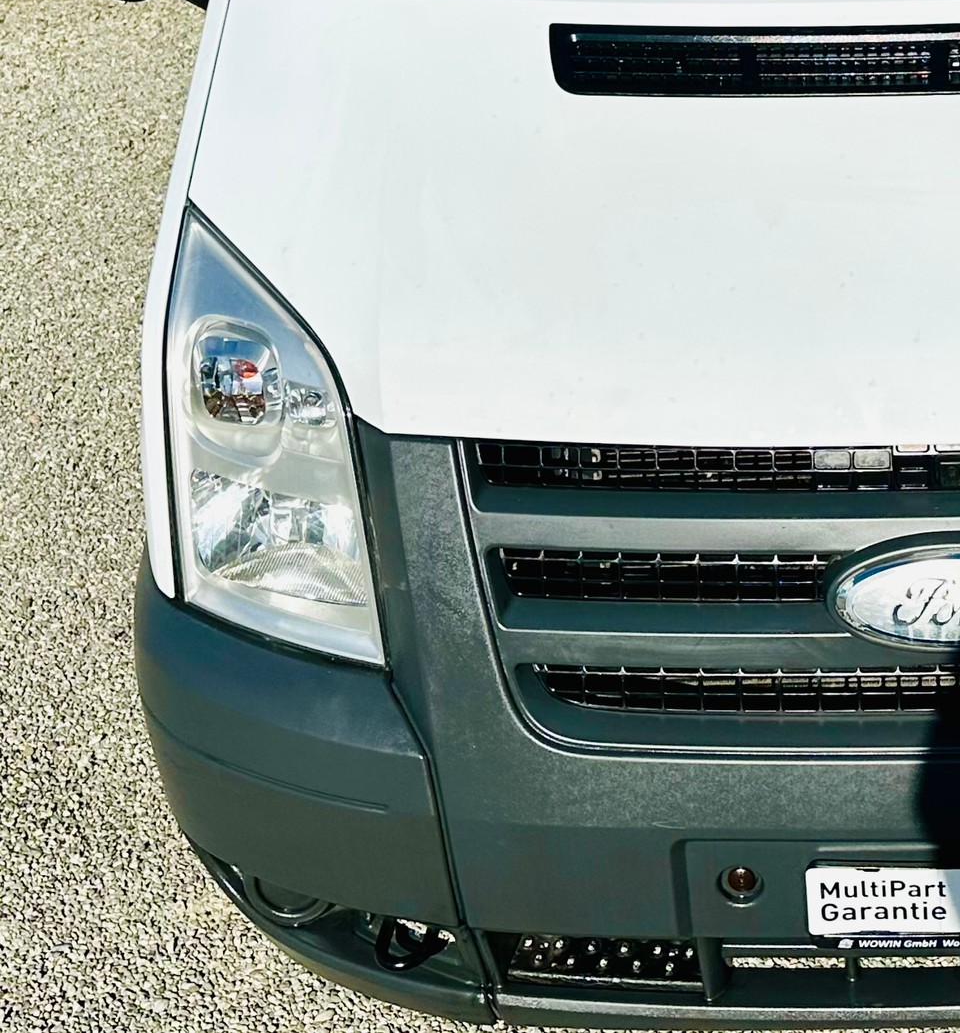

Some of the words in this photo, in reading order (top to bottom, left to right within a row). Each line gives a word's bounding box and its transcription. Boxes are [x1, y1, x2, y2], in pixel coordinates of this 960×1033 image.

[819, 879, 947, 900] MultiPart
[820, 901, 948, 922] Garantie
[858, 939, 902, 948] WOWIN
[903, 939, 938, 948] GmbH
